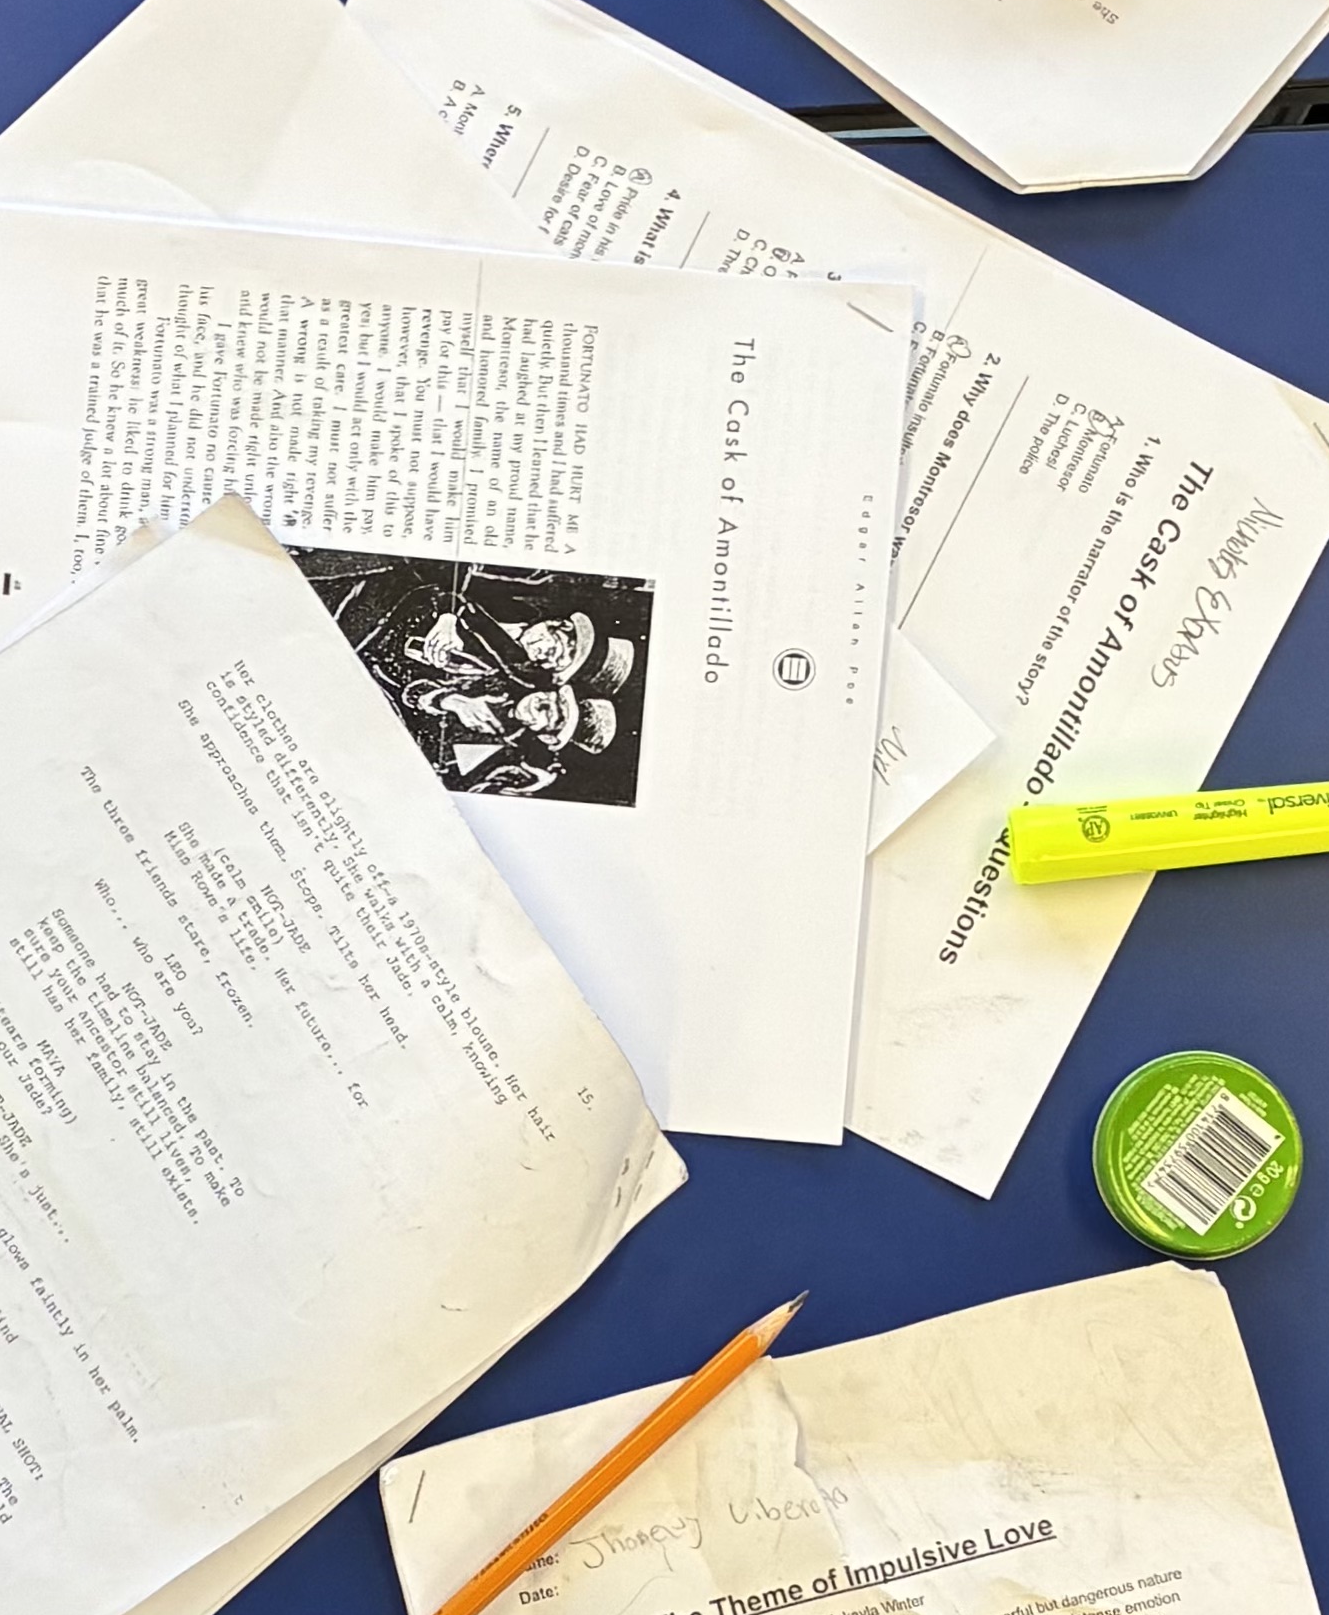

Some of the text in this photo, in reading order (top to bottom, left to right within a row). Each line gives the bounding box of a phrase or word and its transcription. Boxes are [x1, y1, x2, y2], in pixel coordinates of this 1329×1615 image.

[553, 155, 607, 245] C. Fear of cats
[633, 188, 680, 264] 4. What is
[558, 322, 578, 386] thousand
[555, 391, 569, 427] times
[564, 324, 598, 554] FORTUNATO HAD HURT ME A
[1018, 393, 1069, 474] D. The police
[1070, 402, 1087, 414] C.
[552, 431, 567, 455] and
[900, 352, 1001, 533] 2. Why does Montresor
[1056, 428, 1097, 492] Montresor
[549, 469, 565, 495] had
[704, 338, 755, 683] The Cask of Amontillado
[1171, 461, 1213, 510] The
[544, 498, 561, 553] suffered
[1130, 518, 1180, 589] Cask
[845, 494, 873, 704] Edgar Allan Poe
[1015, 436, 1160, 705] 1. Who is the narrator of the story?
[1113, 593, 1137, 631] of
[1026, 626, 1122, 794] Amontillado
[1192, 809, 1248, 823] Highlighter
[213, 847, 246, 889] (calm
[260, 884, 311, 953] NOT-JADE
[94, 877, 203, 1035] Who... who are you?
[163, 953, 186, 981] LEO
[577, 1086, 594, 1111] 15.
[29, 1277, 73, 1336] faintly
[73, 1343, 89, 1362] in
[88, 1365, 110, 1394] her
[106, 1399, 137, 1443] palm.
[12, 1437, 43, 1480] SHOT:
[812, 1567, 837, 1593] of
[843, 1539, 977, 1586] Impulsive
[984, 1519, 1052, 1549] Love
[518, 1586, 558, 1605] Date:
[879, 1595, 924, 1613] Winter
[1034, 1599, 1060, 1613] but
[1061, 1582, 1134, 1608] dangerous
[1137, 1569, 1182, 1588] nature
